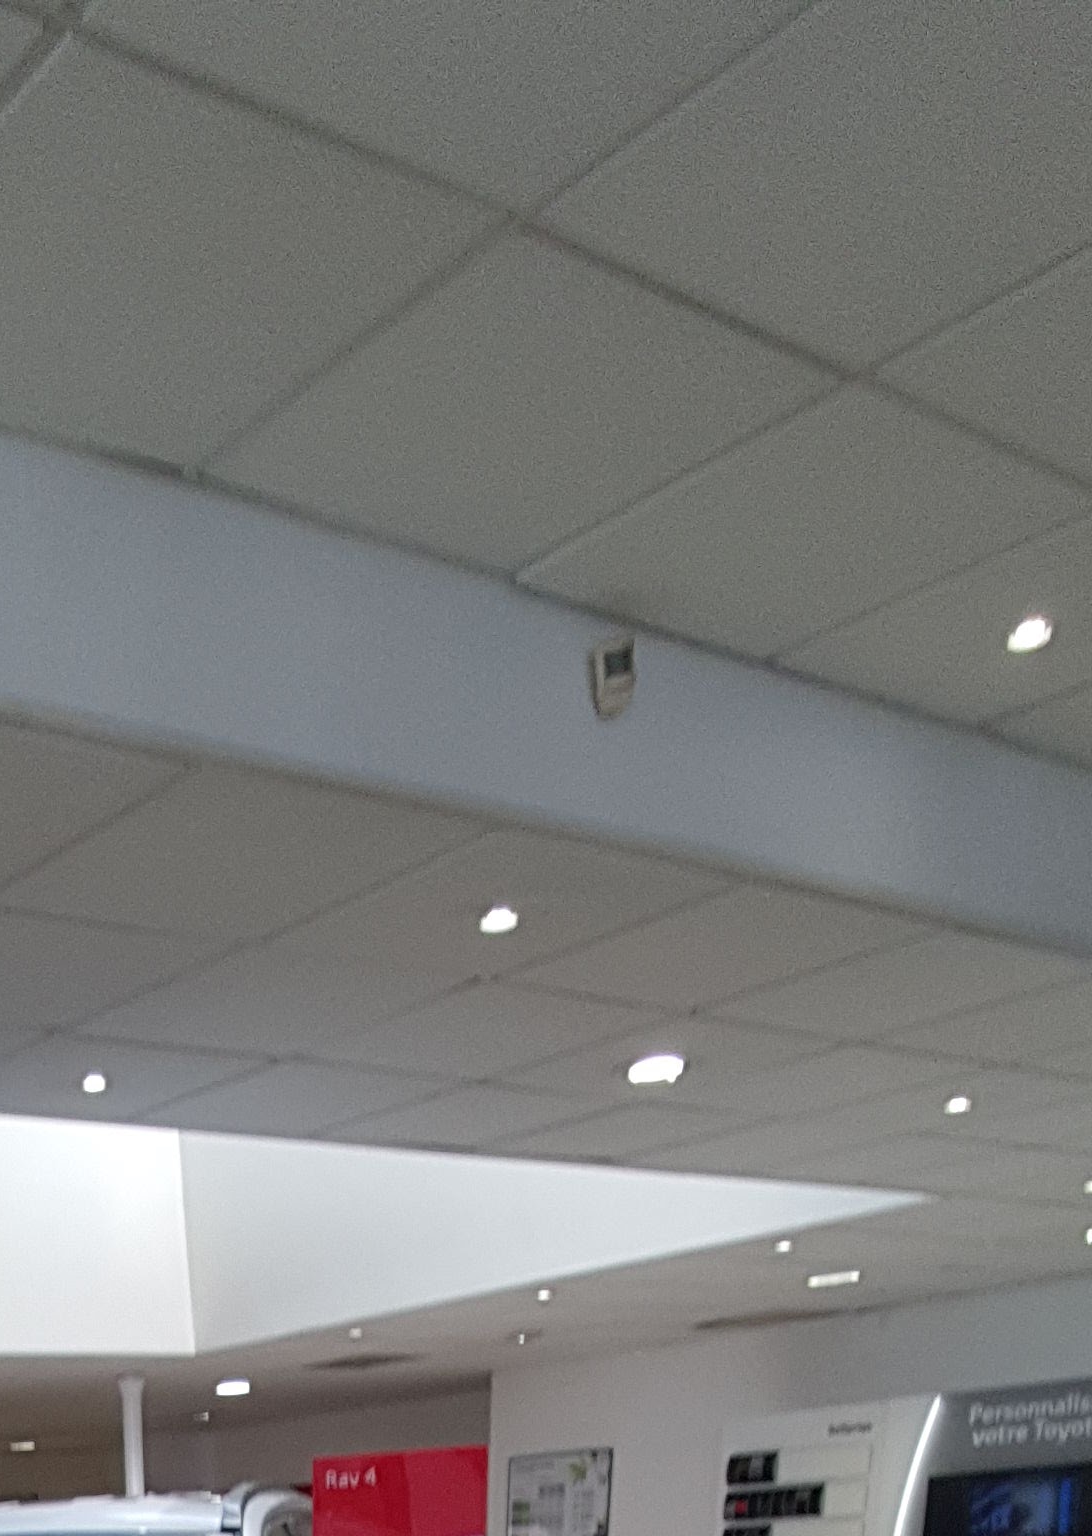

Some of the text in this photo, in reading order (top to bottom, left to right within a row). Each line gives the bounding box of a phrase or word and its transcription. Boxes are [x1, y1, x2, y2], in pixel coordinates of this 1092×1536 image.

[972, 1425, 1028, 1449] votre
[325, 1465, 377, 1490] Rav 4
